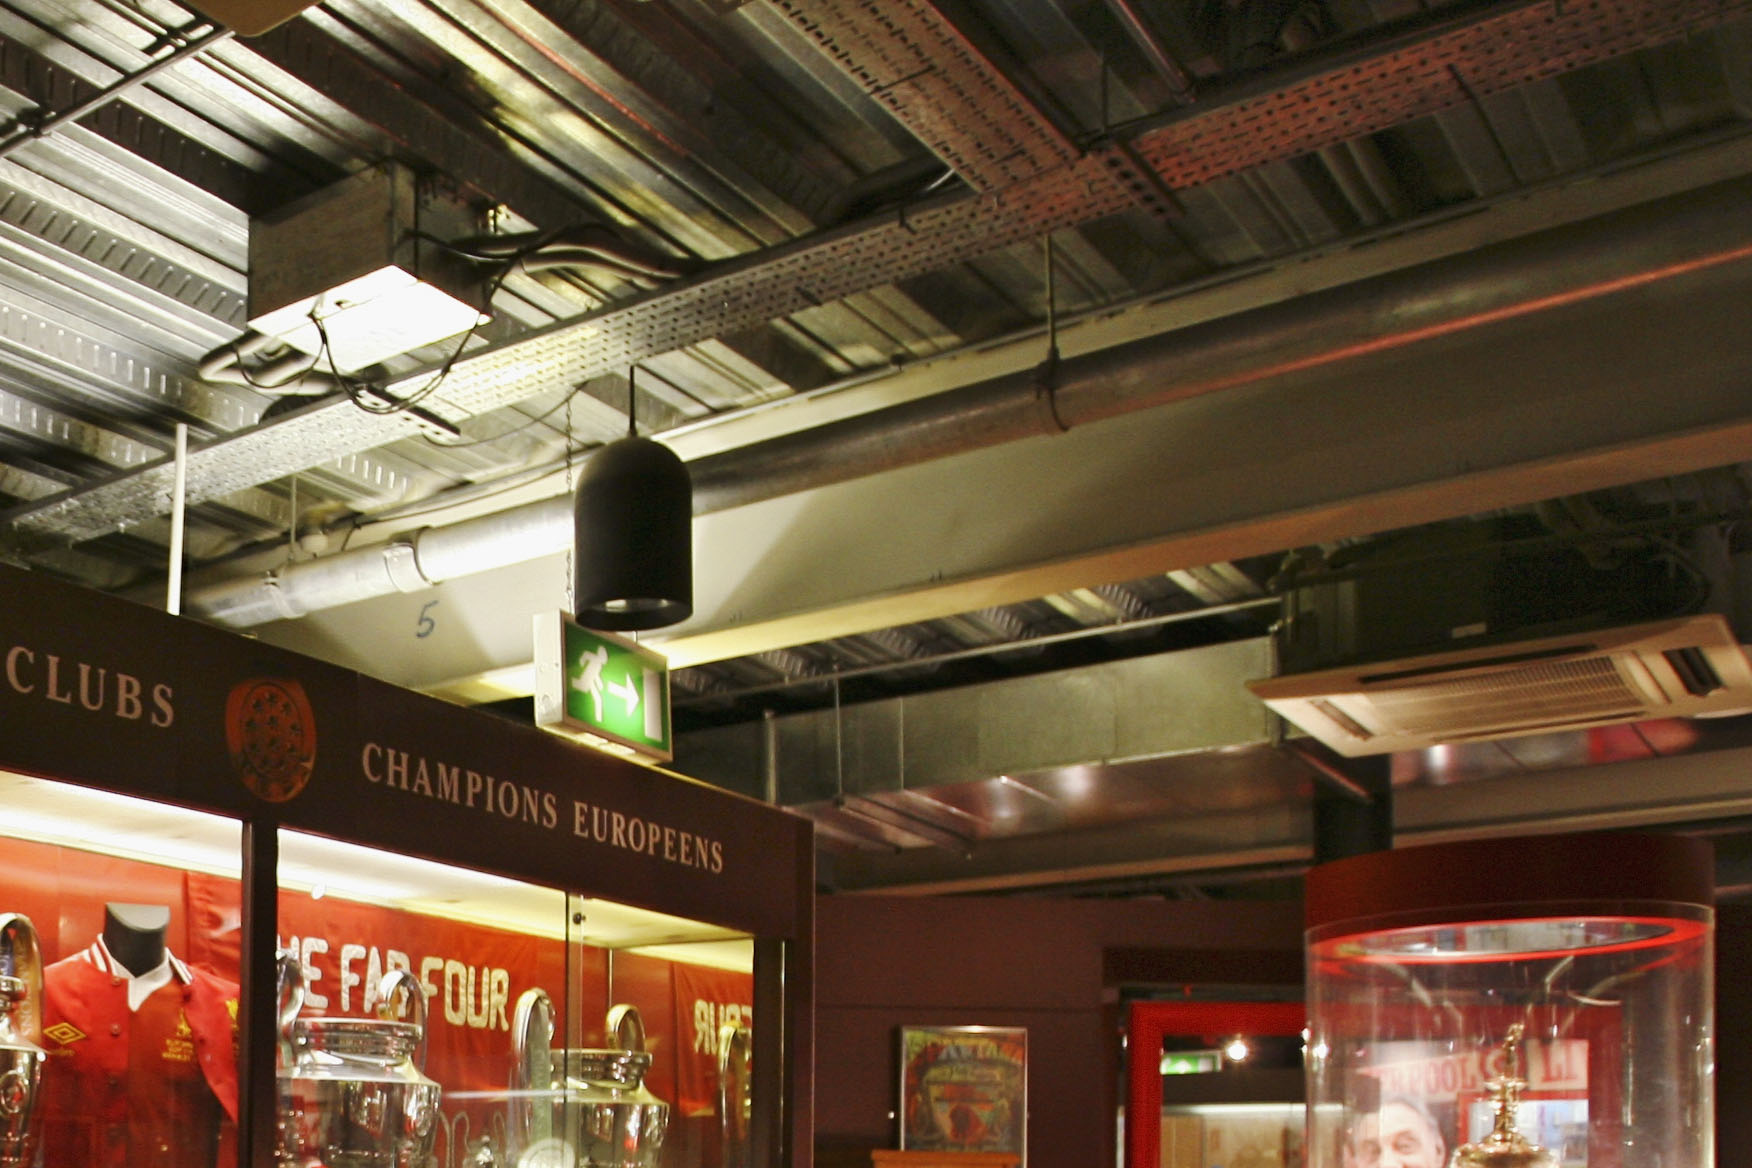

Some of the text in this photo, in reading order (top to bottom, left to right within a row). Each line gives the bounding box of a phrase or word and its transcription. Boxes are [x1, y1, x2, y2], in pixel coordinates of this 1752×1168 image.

[415, 600, 439, 638] 5
[5, 645, 175, 728] CLUBS
[361, 742, 723, 874] CHAMPIONS EUROPEENS
[420, 955, 510, 1032] FOUR
